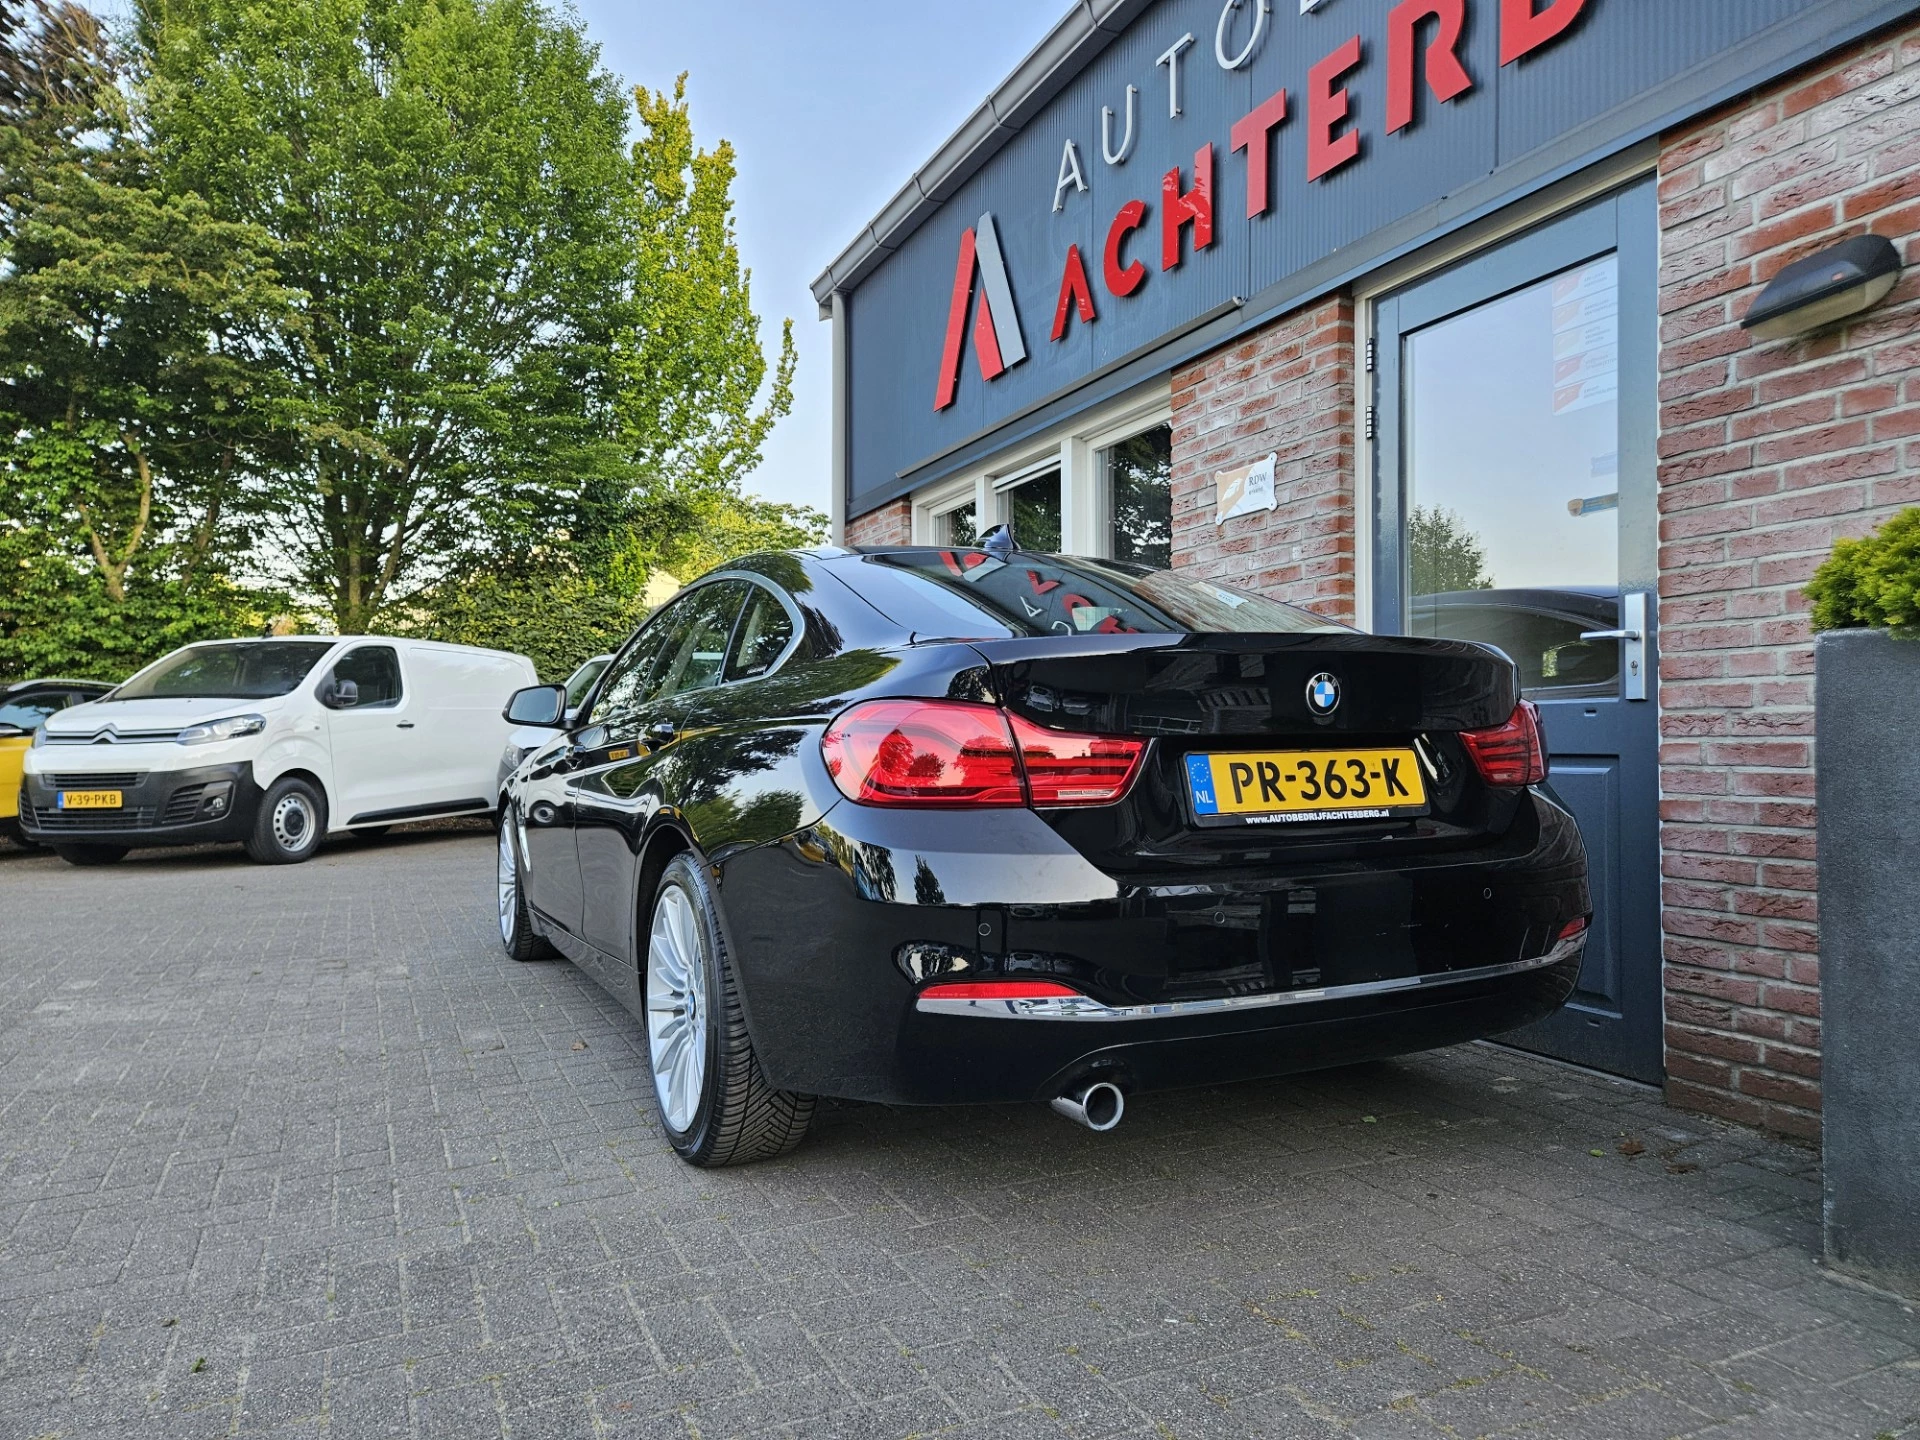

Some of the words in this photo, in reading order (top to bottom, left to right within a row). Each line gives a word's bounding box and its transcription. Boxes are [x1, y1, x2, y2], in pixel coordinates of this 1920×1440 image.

[1052, 0, 1321, 213] AUTO
[1248, 472, 1268, 487] RDW
[1229, 758, 1410, 804] PR-363-K
[66, 794, 117, 805] V-39-PKB
[1195, 790, 1214, 804] NL
[1245, 809, 1390, 824] www.AUTOBEDRIJFACHTERBERG.nl
